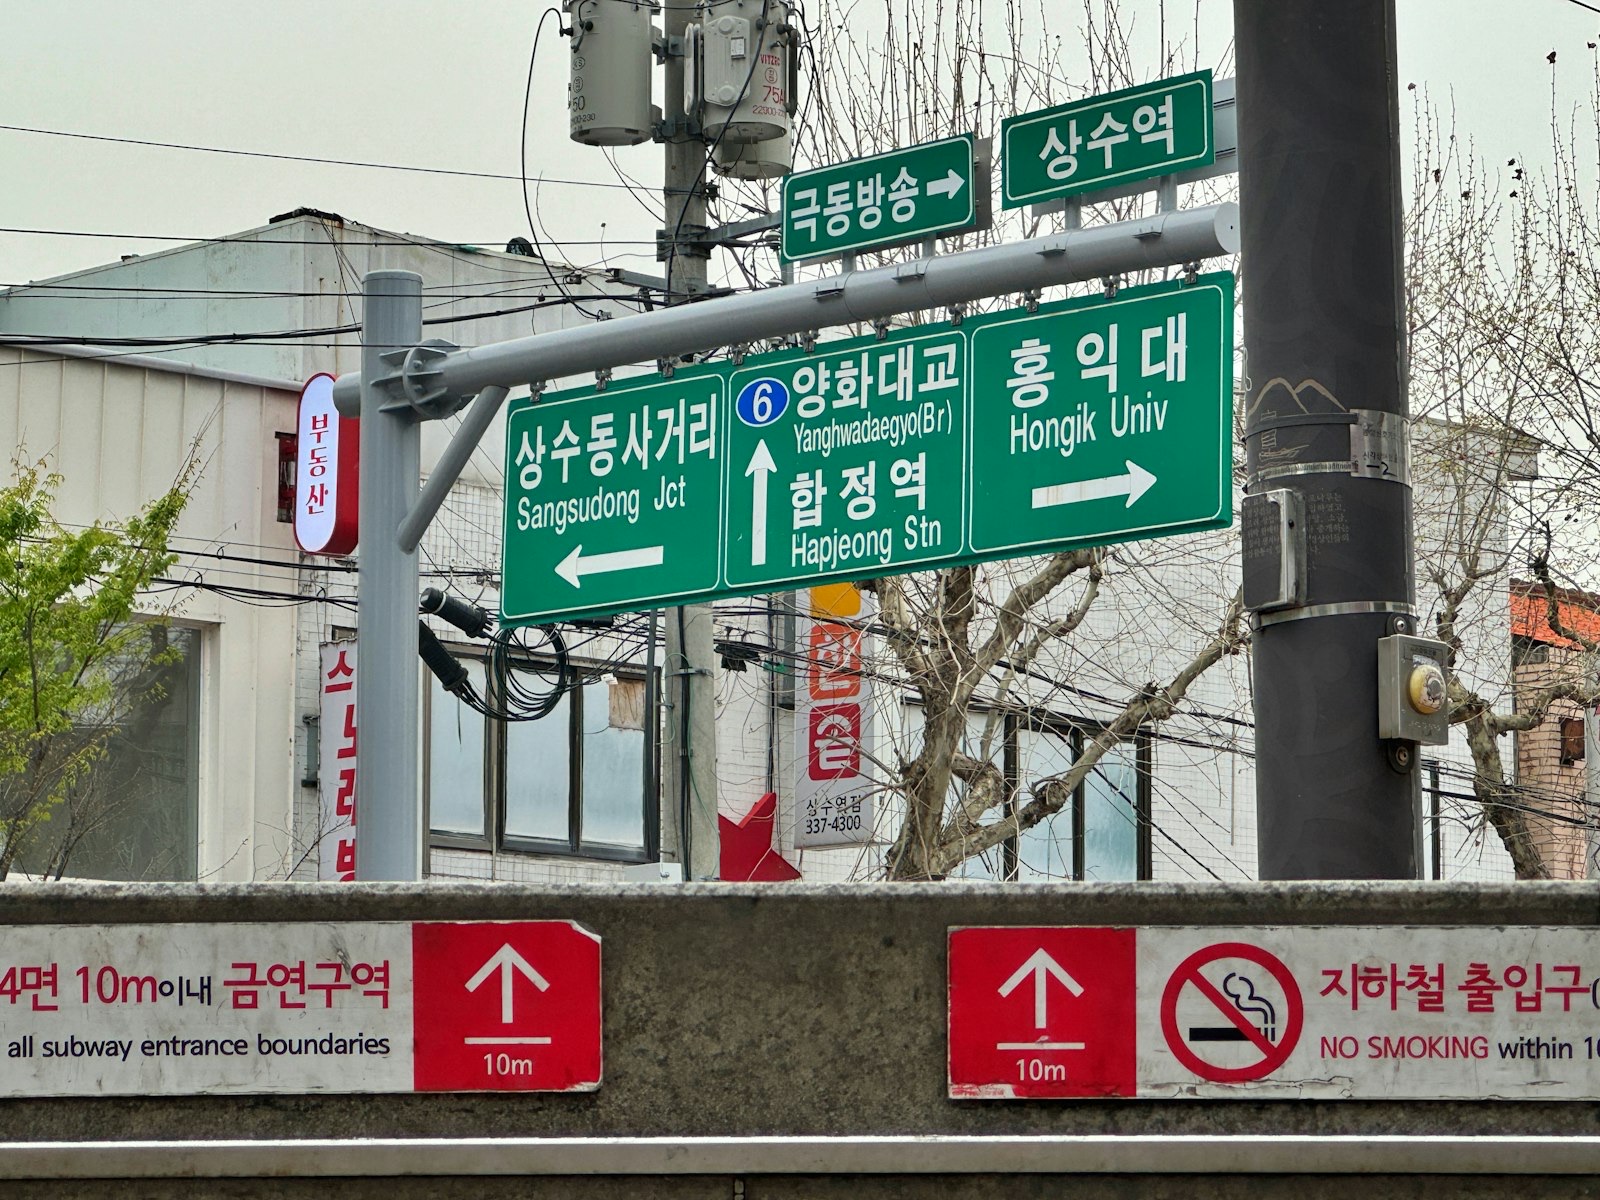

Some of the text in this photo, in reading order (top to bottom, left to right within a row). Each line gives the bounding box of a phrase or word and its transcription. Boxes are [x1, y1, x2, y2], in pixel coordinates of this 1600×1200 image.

[1039, 95, 1175, 181] 상수역
[790, 166, 920, 242] 극동방송
[752, 382, 773, 422] 6
[792, 343, 960, 419] 양화대교
[515, 393, 717, 490] 상수동사거리
[794, 399, 952, 457] Yanghwadaegyo(Br)
[1010, 391, 1168, 457] Hongik Univ
[306, 413, 329, 515] 부동산
[517, 475, 686, 535] Sangsudong Jct
[791, 514, 941, 572] Hapjeong Stn
[806, 815, 861, 835] 337-4300
[75, 965, 212, 1006] 10m이내
[223, 960, 390, 1009] 금연구역
[1319, 963, 1445, 1013] 지하철
[8, 1033, 391, 1062] all subway entrance boundaries
[483, 1053, 533, 1076] 10m
[1015, 1059, 1066, 1081] 10m
[1320, 1035, 1600, 1060] NO SMOKING within 1
